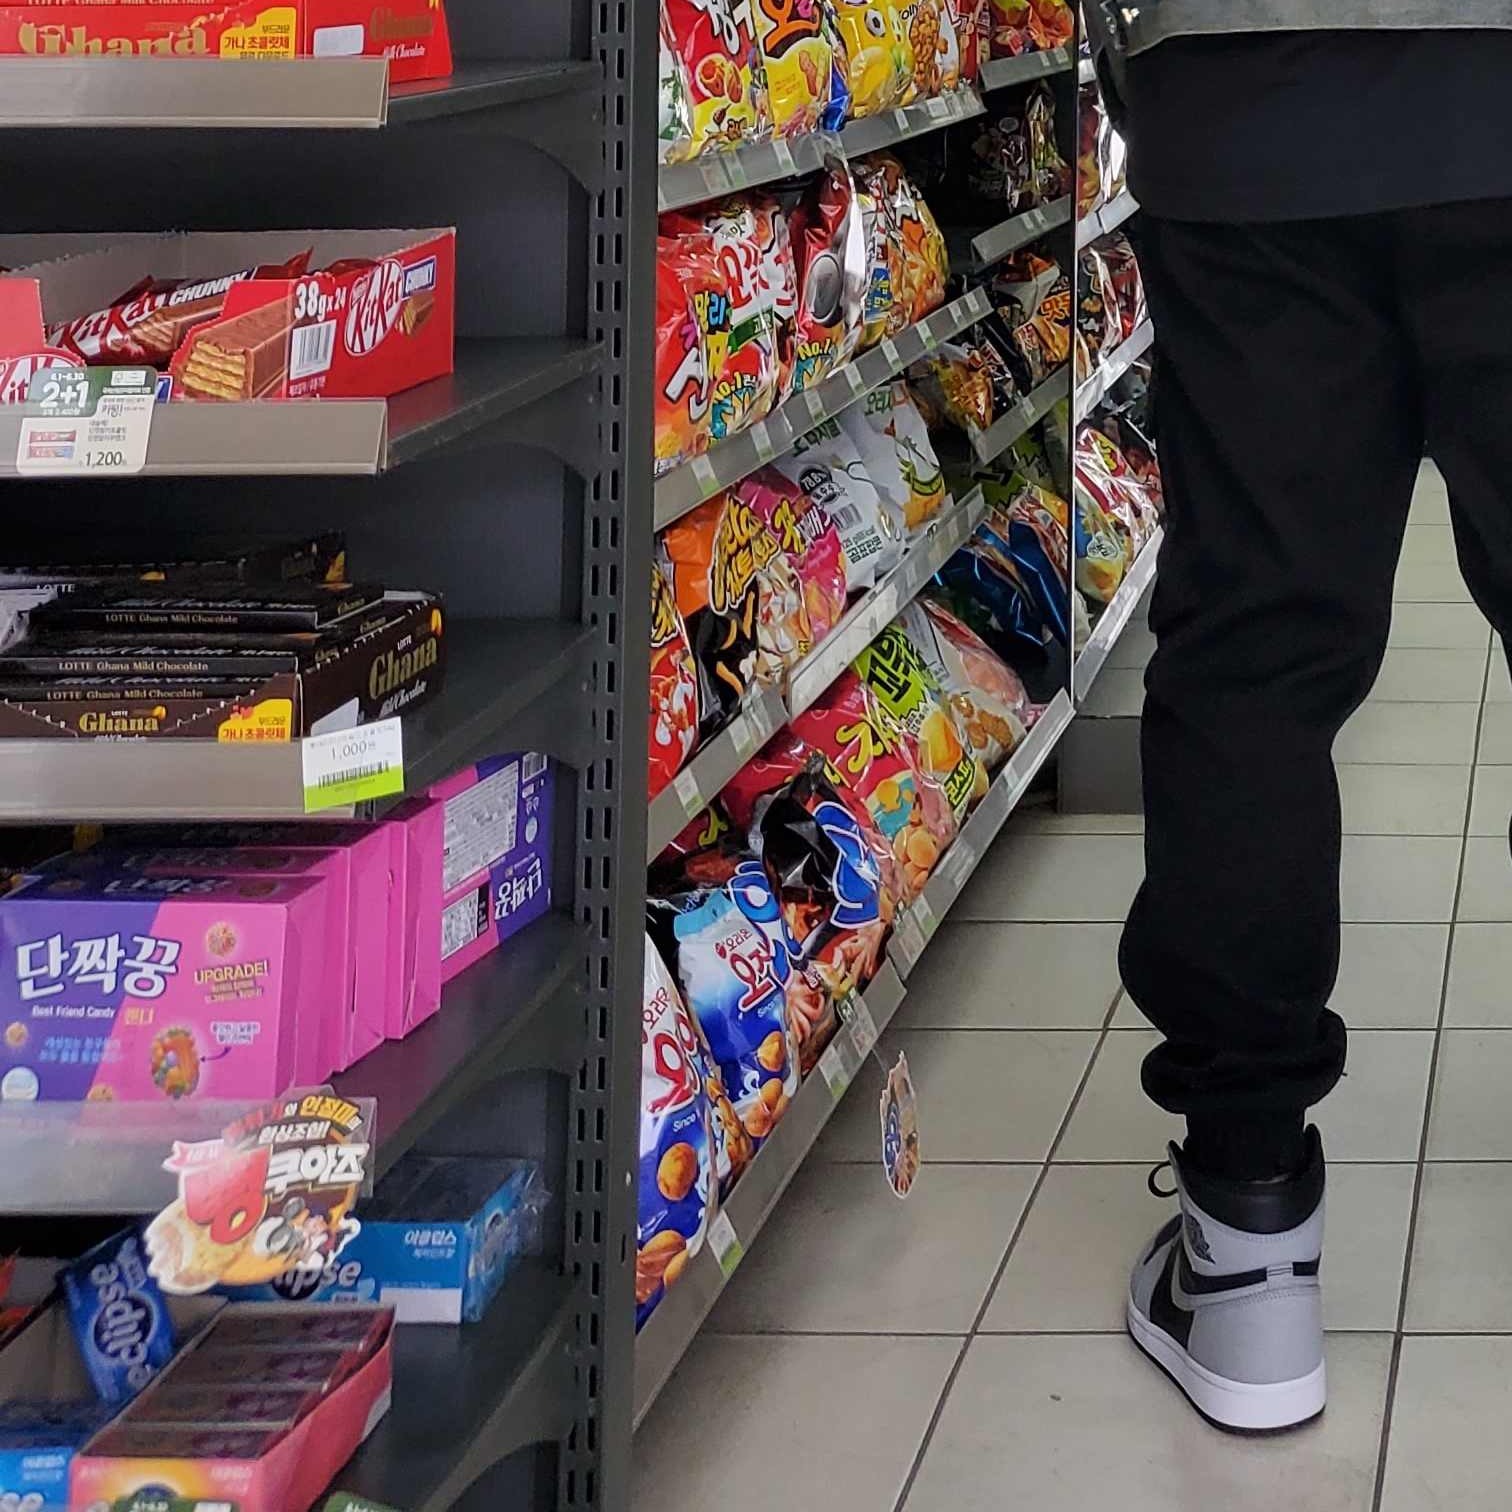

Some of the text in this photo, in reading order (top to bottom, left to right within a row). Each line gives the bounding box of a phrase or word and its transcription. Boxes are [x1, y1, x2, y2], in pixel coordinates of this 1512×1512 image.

[224, 36, 246, 50] 가나
[404, 261, 435, 291] CHUNKY
[169, 271, 249, 306] CHUNKY
[39, 381, 88, 408] 2+1
[85, 451, 123, 468] 1,200
[106, 614, 239, 625] LOTTE Ghana Mild Chocolate
[59, 661, 209, 672] LOTTE Ghana Mild Chocolate
[369, 634, 438, 700] Ghana
[47, 688, 203, 700] LOTTE Ghana Mild Chocolate
[79, 711, 159, 733] Ghana
[223, 727, 243, 740] 가나
[330, 740, 377, 760] 1,000원
[725, 928, 753, 952] 오리온
[17, 932, 182, 1001] 단짝꿍
[194, 959, 268, 985] UPGRADE!
[56, 1005, 85, 1018] Friend
[87, 1005, 115, 1019] Candy
[672, 1113, 697, 1133] Since
[264, 1142, 370, 1196] 쿠아즈
[405, 1230, 457, 1245] 이클립스
